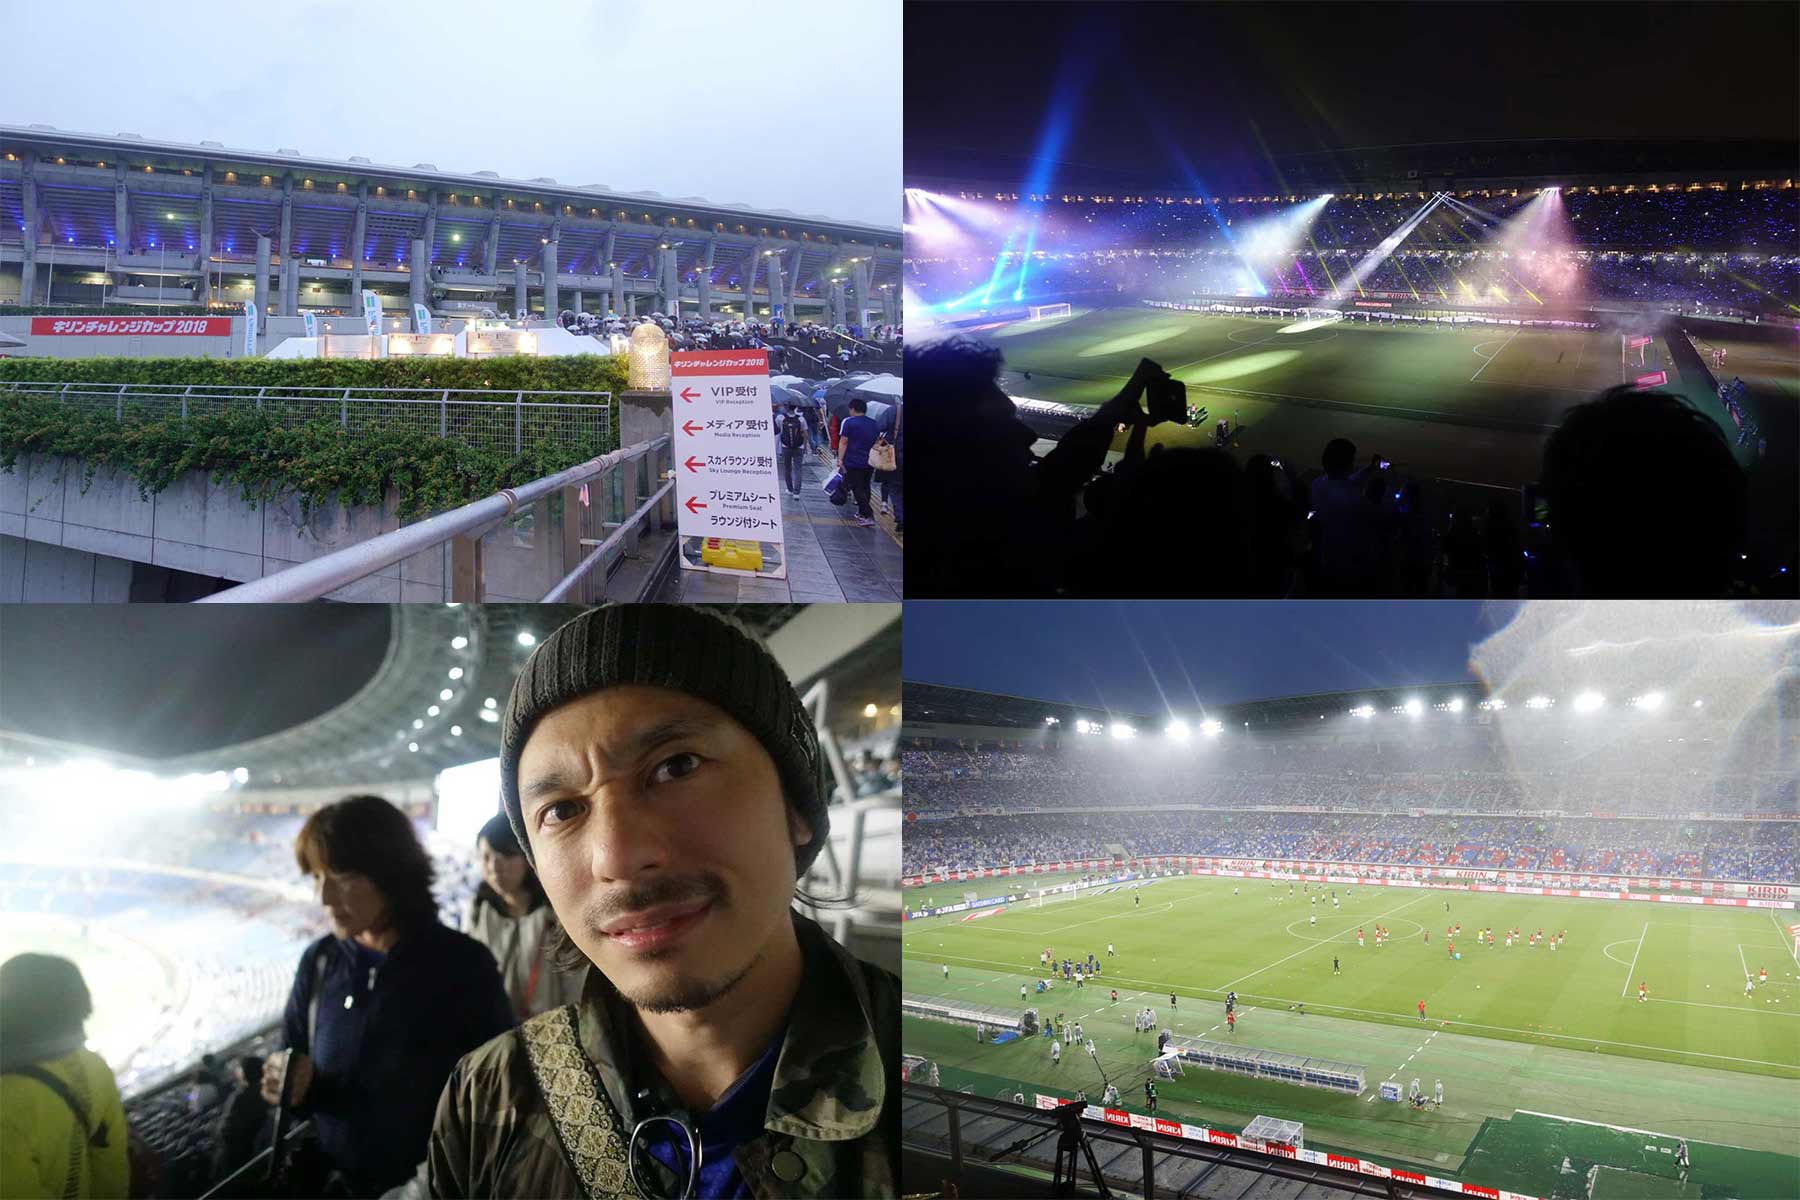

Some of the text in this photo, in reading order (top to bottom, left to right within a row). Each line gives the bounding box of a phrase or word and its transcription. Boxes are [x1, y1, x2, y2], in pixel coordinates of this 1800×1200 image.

[707, 455, 773, 468] スカイラウンジ受付
[709, 490, 776, 504] プレミアムシート
[710, 515, 778, 529] ラウンジ付シート
[1456, 870, 1488, 878] KIRIN
[1747, 885, 1789, 894] KIRIN
